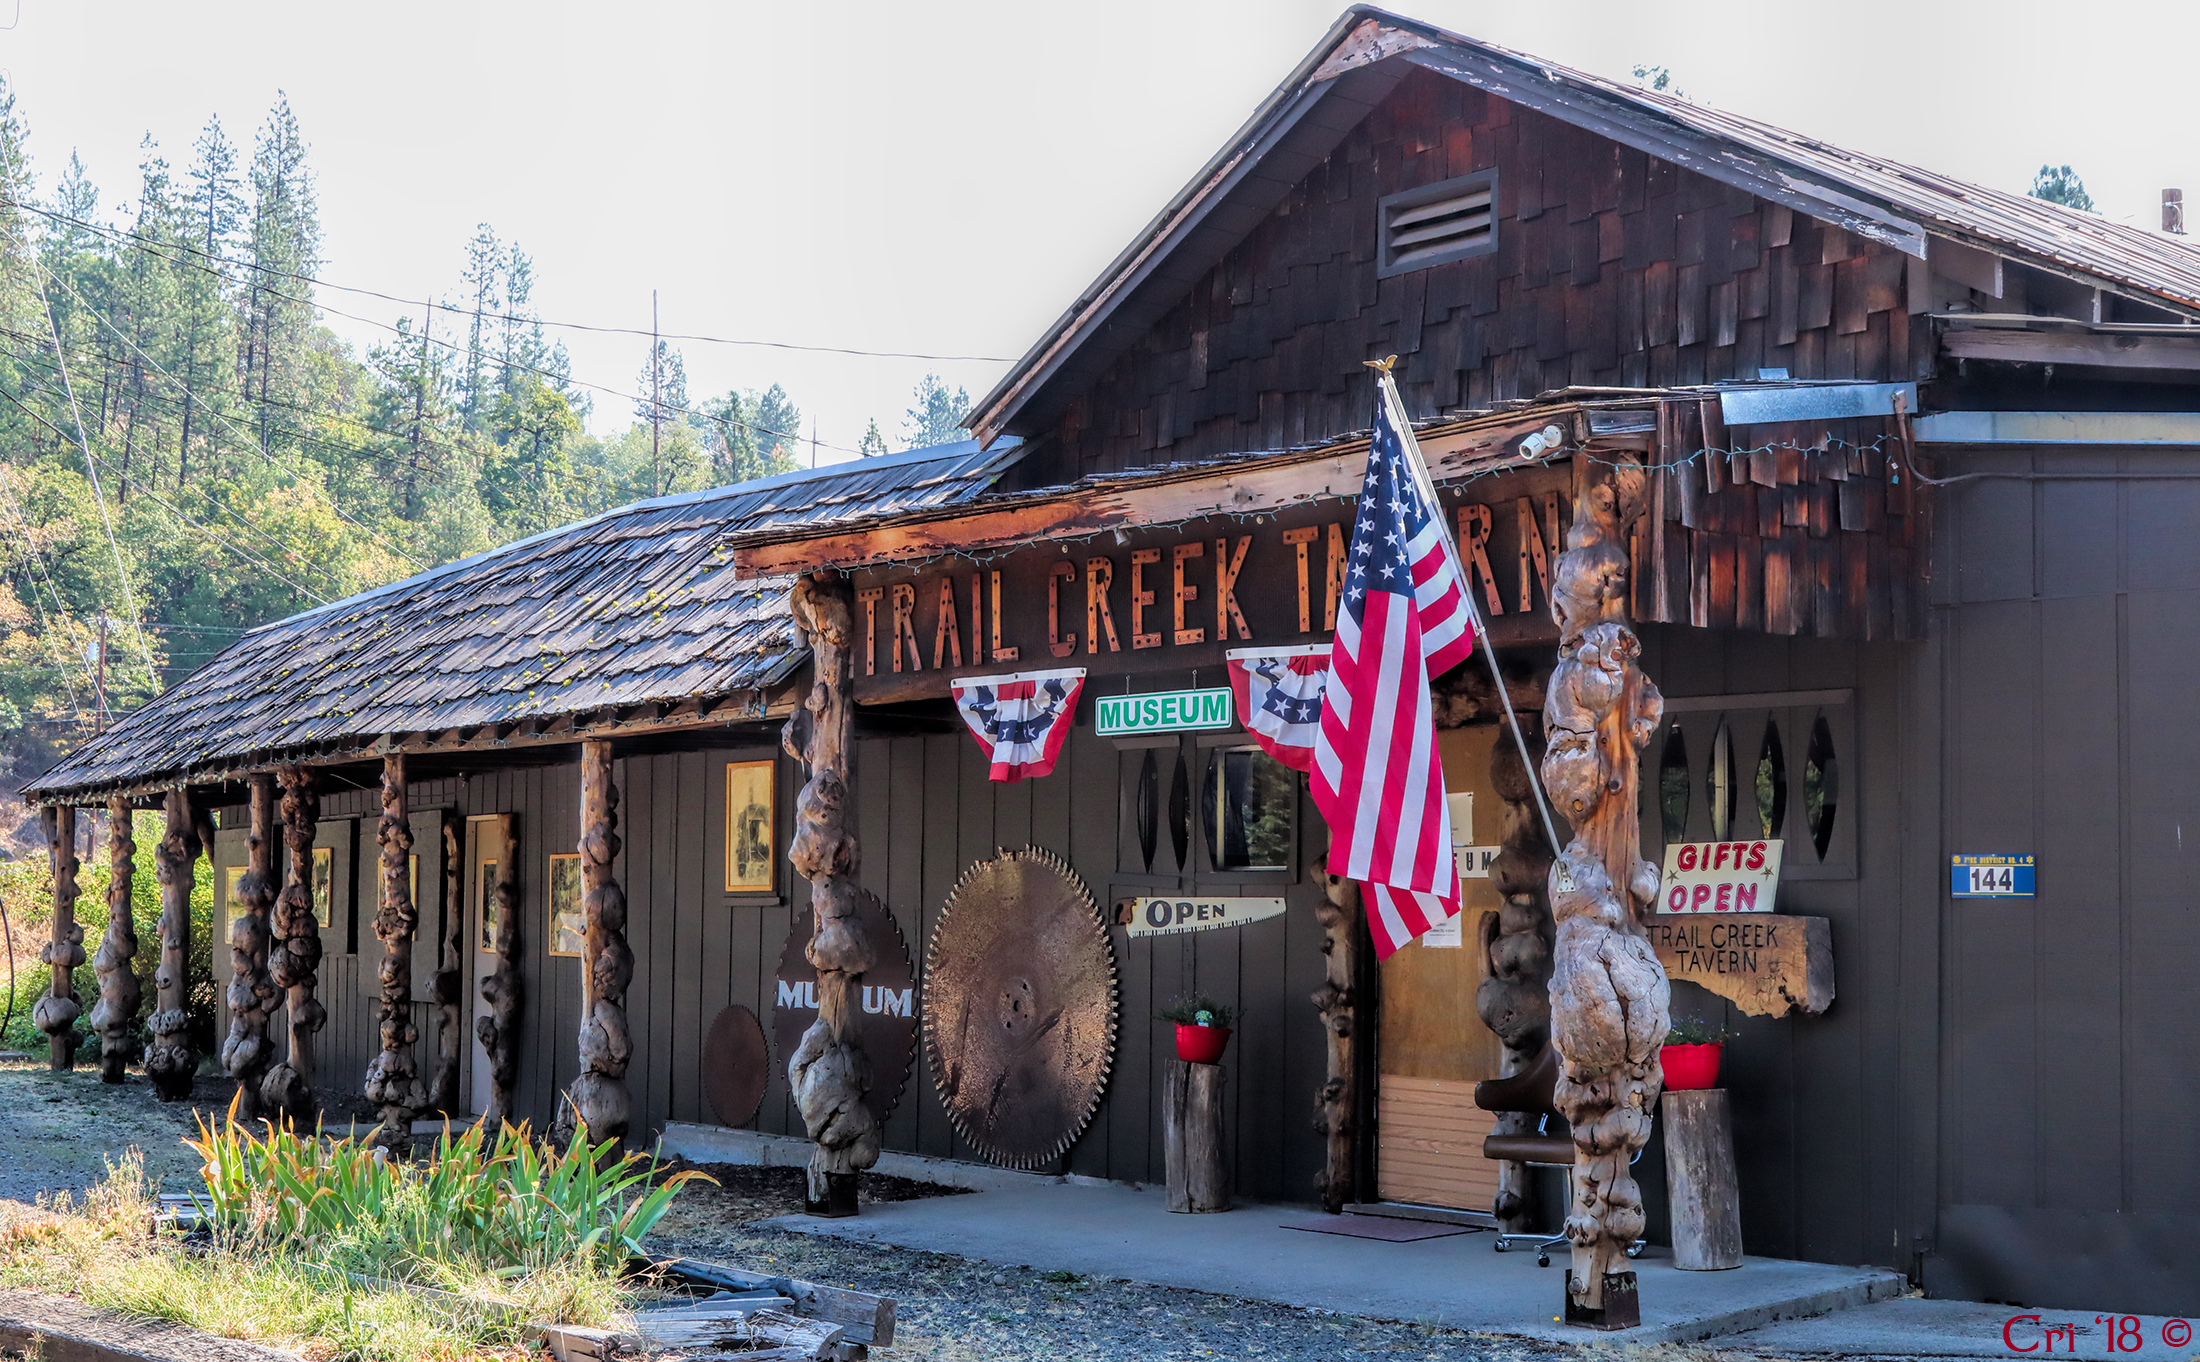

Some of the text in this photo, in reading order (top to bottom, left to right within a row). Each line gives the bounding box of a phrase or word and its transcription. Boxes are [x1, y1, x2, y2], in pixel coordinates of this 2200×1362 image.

[857, 490, 1560, 676] TRAIL CREEK TARN
[1099, 694, 1227, 729] MUSEUM
[1677, 841, 1768, 872] GIFTS
[1971, 868, 2012, 891] 144
[1667, 883, 1758, 913] OPEN
[1145, 899, 1226, 928] OPEN
[1646, 924, 1779, 949] TRAIL CREEK
[1675, 950, 1758, 974] TAVERN
[777, 980, 913, 1018] MUUM
